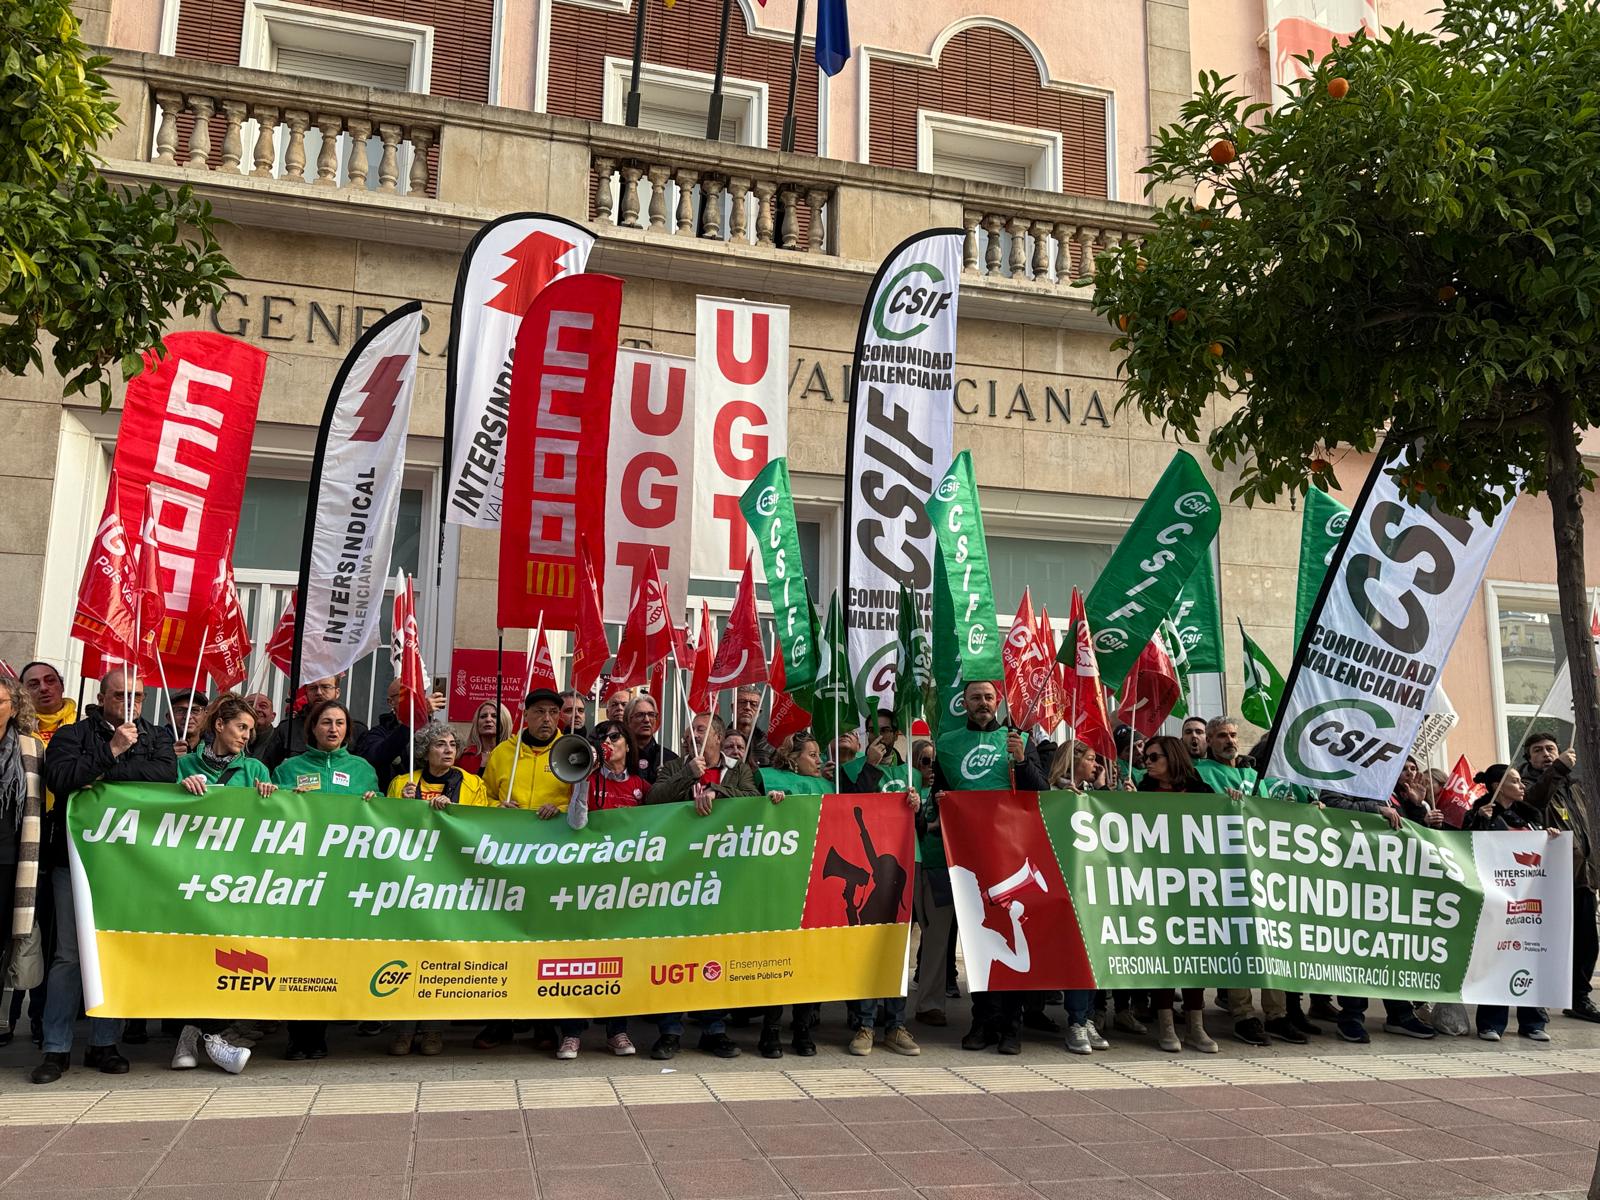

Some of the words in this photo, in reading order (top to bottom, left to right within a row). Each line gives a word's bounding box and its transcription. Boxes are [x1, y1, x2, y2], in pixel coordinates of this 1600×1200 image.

[888, 284, 953, 322] CSIF
[860, 344, 953, 371] COMUNIDAD
[858, 364, 953, 391] VALENCIANA
[713, 309, 770, 571] UGT
[615, 362, 687, 605] UGT
[856, 386, 934, 591] CSIF
[938, 480, 961, 496] CSIF
[762, 492, 780, 509] CSIF
[1183, 497, 1211, 516] CSIF
[323, 467, 376, 643] INTERSINDICAL
[347, 554, 373, 646] VALENCIANA
[971, 632, 988, 645] CSIF
[1101, 634, 1129, 651] CSIF
[1181, 633, 1203, 644] CSIF
[794, 642, 807, 657] CSIF
[1311, 624, 1437, 687] COMUNIDAD
[469, 675, 522, 684] GENERLITAT
[1301, 648, 1426, 711] VALENCIANA
[1308, 720, 1403, 769] CSIF
[968, 754, 1002, 767] CSIF
[82, 807, 141, 845] JA
[152, 811, 245, 852] N'HI
[250, 819, 308, 856] HA
[318, 824, 441, 862] PROU!
[460, 829, 667, 865] -burocràcia
[688, 823, 800, 860] -ràtios
[1070, 810, 1170, 854] SOM
[1182, 814, 1465, 882] NECESSÀRIES
[1495, 878, 1517, 887] STAS
[178, 869, 327, 907] +salari
[348, 874, 526, 916] +plantilla
[549, 870, 722, 912] +valencià
[1085, 865, 1097, 905] I
[1106, 866, 1461, 929] IMPRESCINDIBLES
[1101, 915, 1158, 946] ALS
[1165, 916, 1293, 950] CENTRES
[1299, 923, 1449, 964] EDUCATIUS
[1496, 940, 1512, 951] UGT
[420, 960, 461, 971] Central
[464, 961, 508, 971] Sindical
[541, 961, 595, 977] CCOO
[729, 957, 792, 970] Ensenyament
[1108, 956, 1170, 975] PERSONAL
[1173, 952, 1242, 976] D'ATENCIÓ
[1299, 963, 1389, 987] D'ADMINISTRACIÓ
[1398, 971, 1441, 990] SERVEIS
[216, 975, 276, 992] STEPV
[378, 971, 412, 985] CSIF
[419, 975, 498, 986] Independiente
[501, 976, 508, 987] y
[650, 963, 699, 986] UGT
[729, 973, 756, 982] Serveis
[757, 972, 782, 980] Públics
[784, 971, 794, 979] PV
[1514, 977, 1534, 988] CSIF
[417, 989, 432, 998] de
[435, 989, 508, 999] Funcionarios
[537, 979, 622, 998] educació
